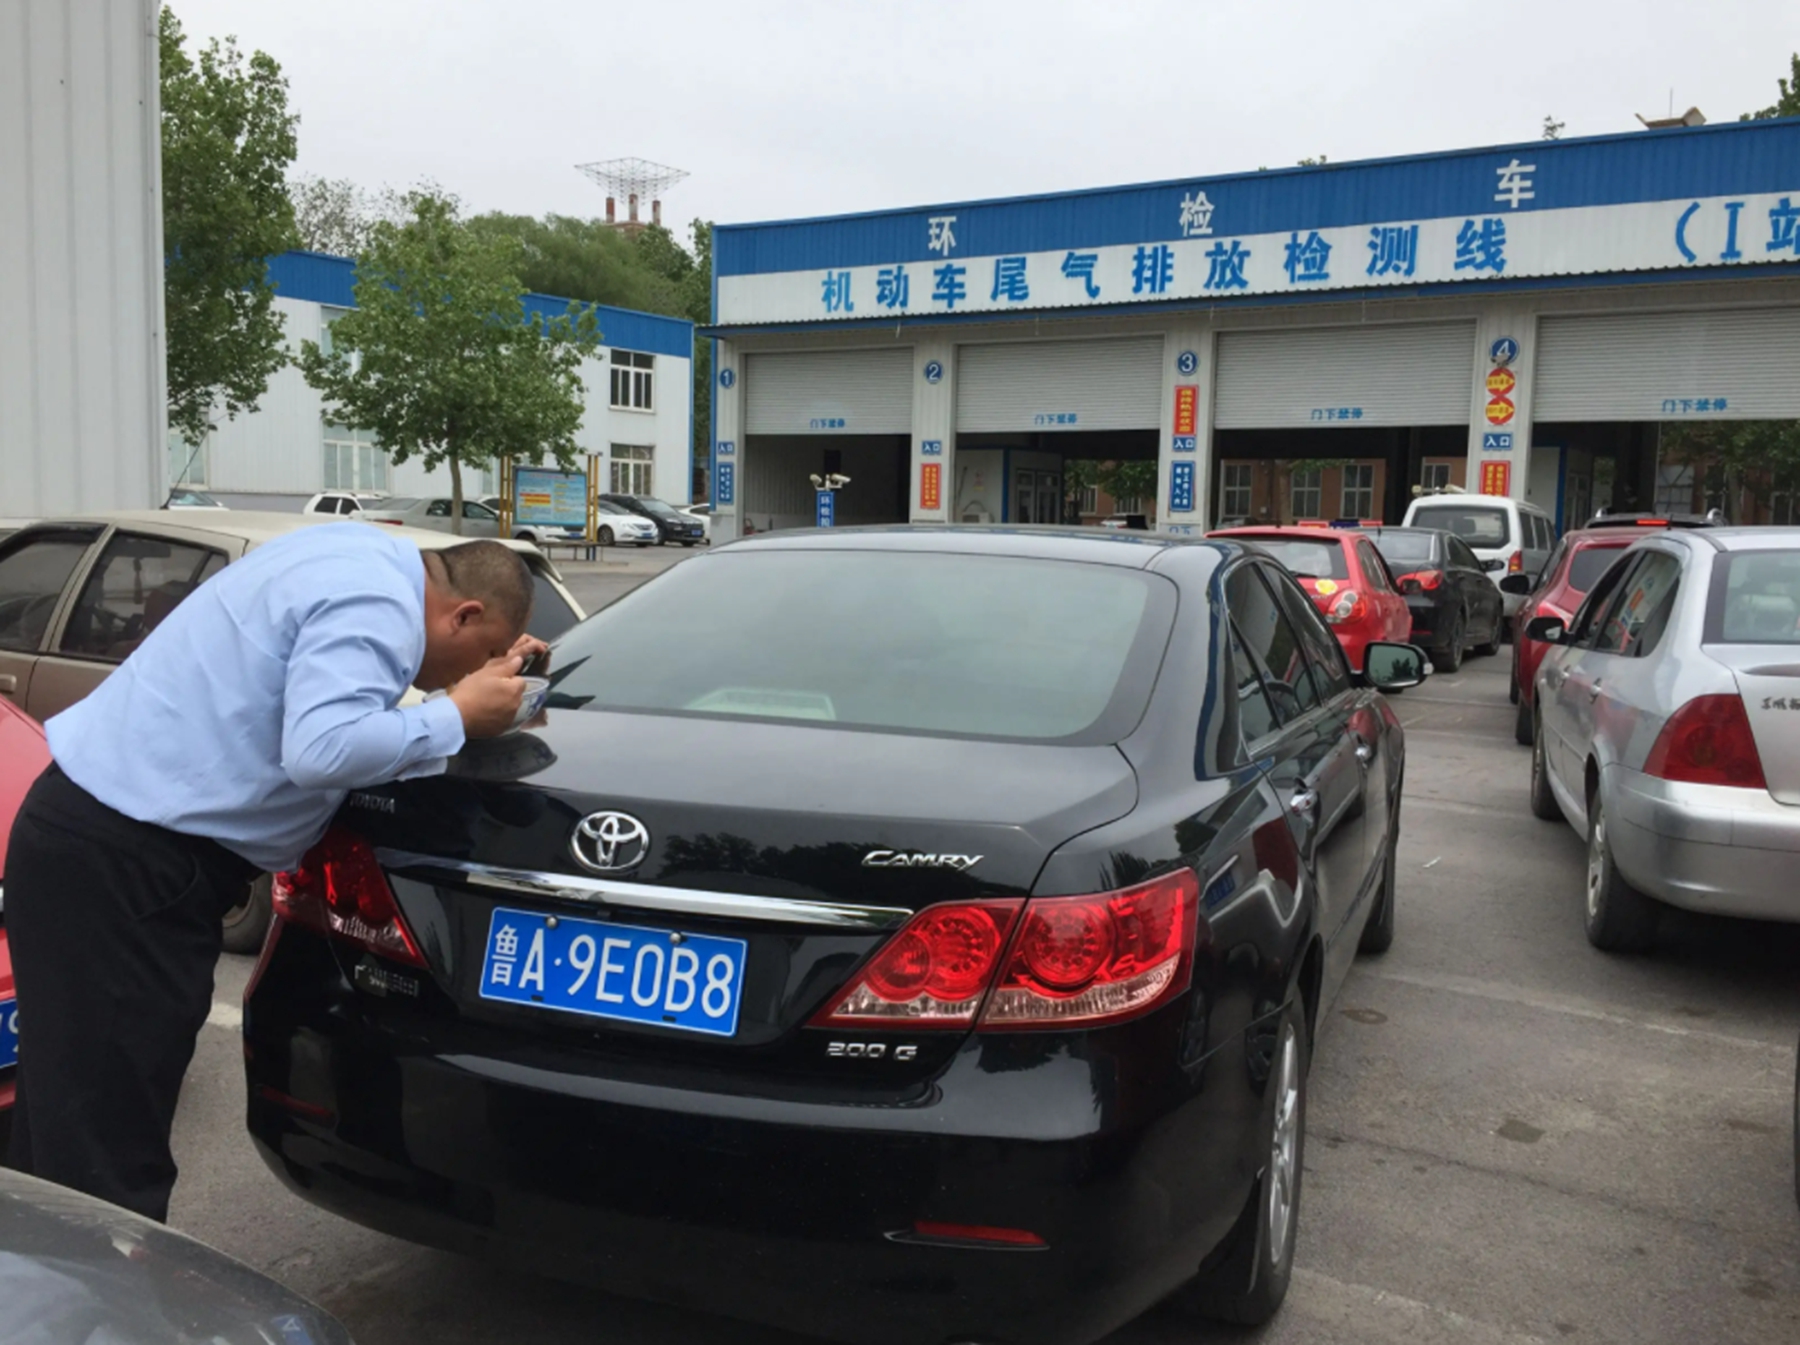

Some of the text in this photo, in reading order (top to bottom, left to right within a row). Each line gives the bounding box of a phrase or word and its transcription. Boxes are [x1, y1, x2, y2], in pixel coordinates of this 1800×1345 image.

[822, 218, 1507, 313] 机动车尾气排放检测线
[1496, 340, 1511, 356] 4
[1181, 353, 1194, 372] 3
[723, 370, 730, 387] 1
[928, 363, 939, 381] 2
[719, 444, 734, 453] 入口
[923, 444, 941, 453] 入口
[1174, 438, 1195, 449] 入口
[1485, 435, 1510, 447] 入口
[827, 1041, 918, 1061] 200 G
